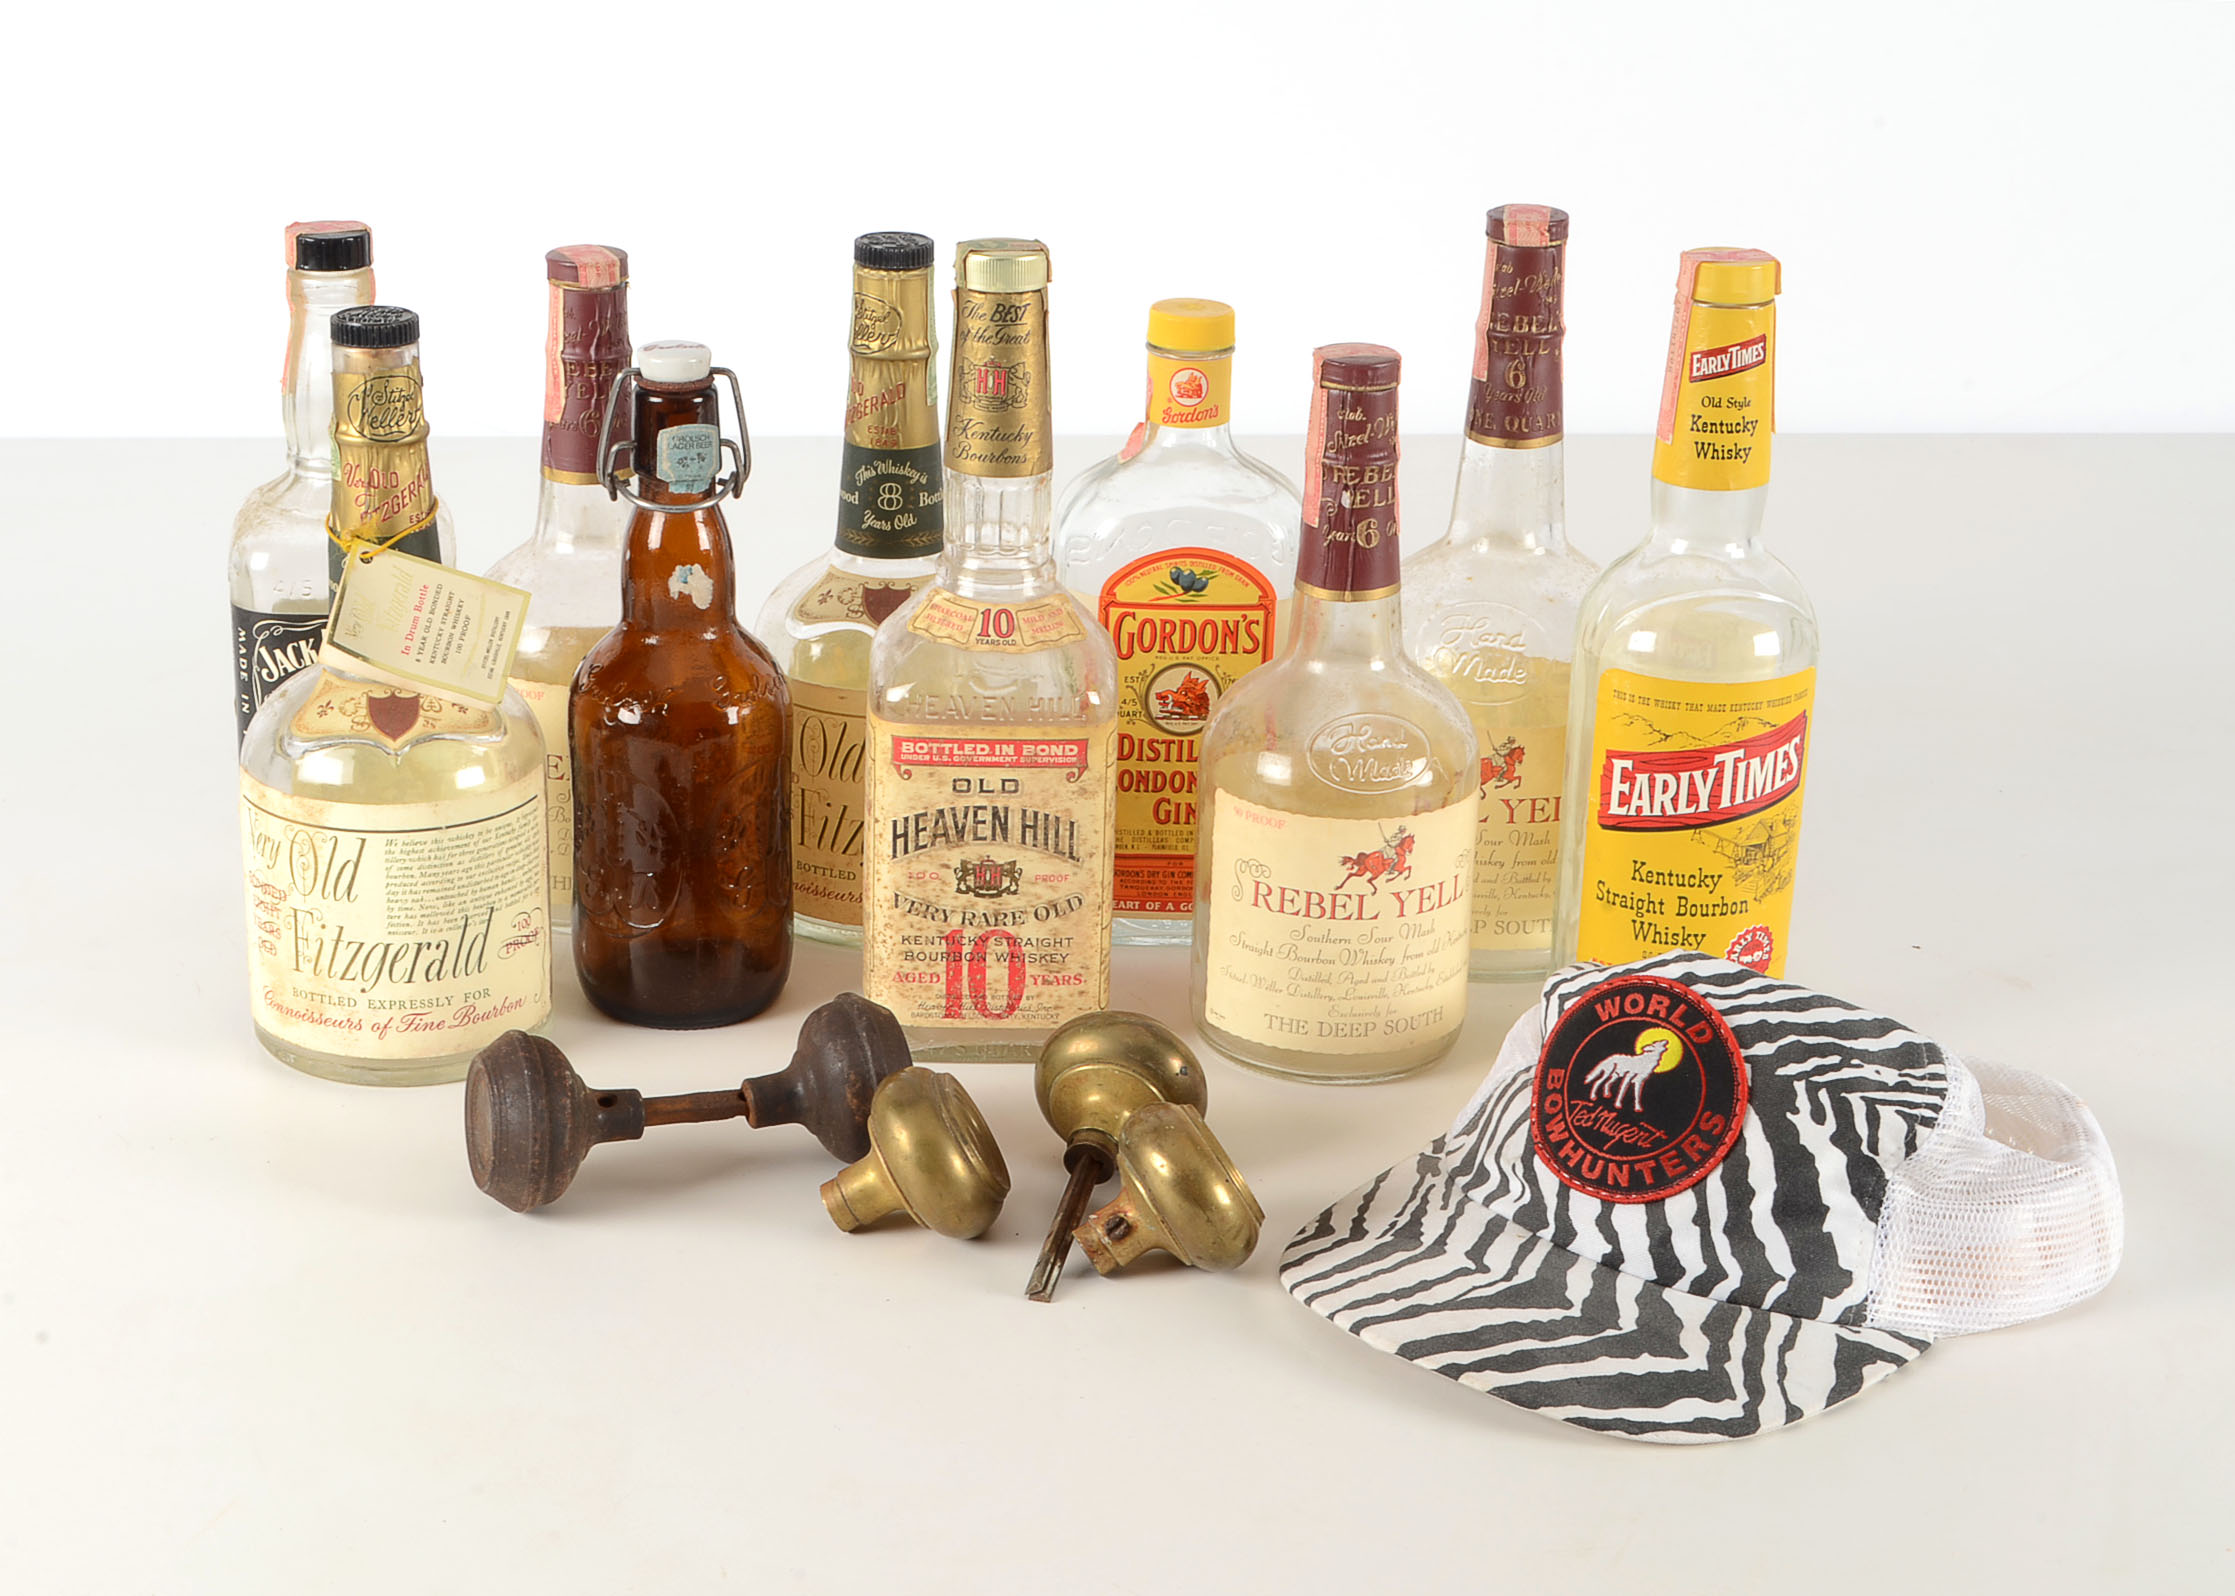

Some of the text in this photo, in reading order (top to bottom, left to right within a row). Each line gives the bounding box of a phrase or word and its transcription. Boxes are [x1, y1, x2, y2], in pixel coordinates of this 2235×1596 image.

[961, 300, 1030, 322] The BEST
[972, 326, 994, 345] the
[994, 326, 1032, 345] Great
[1504, 359, 1526, 390] 6
[1162, 404, 1219, 424] Gordon's
[1701, 396, 1752, 410] Old Style
[952, 416, 1033, 450] Kentucky
[1690, 414, 1758, 438] Kentucky
[952, 441, 1028, 465] Bourbons
[1694, 440, 1752, 464] Whisky
[370, 468, 400, 489] OLD
[855, 458, 928, 486] This Whiskey is
[878, 482, 902, 510] 8
[862, 509, 918, 531] Years Old
[1356, 518, 1380, 548] 6
[400, 584, 430, 656] In Drum Bottle
[430, 591, 455, 664] KENTUCKY STRAIGHT
[461, 614, 472, 642] PROOF
[978, 608, 1015, 640] 10
[416, 636, 428, 656] YEAR
[424, 617, 433, 634] OLD
[441, 632, 454, 664] BOURBON
[976, 638, 1017, 646] YEARS OLD
[1113, 611, 1260, 660] GORDON'S
[236, 626, 250, 714] MADE IN
[258, 635, 319, 682] JACK
[1638, 696, 1651, 706] THE
[1654, 698, 1681, 711] WHISKY
[1685, 702, 1704, 712] THAT
[1707, 704, 1727, 712] MADE
[1730, 701, 1762, 712] KENTUCKY
[900, 754, 930, 762] UNDER
[953, 756, 1018, 764] GOVERNMENT
[902, 741, 1079, 756] BOTTLED IN BOND
[952, 778, 1020, 795] OLD
[1117, 768, 1198, 794] ONDON
[892, 805, 1081, 862] HEAVEN HILL
[1245, 810, 1287, 830] PROOF
[1509, 829, 1550, 848] Mash
[283, 823, 366, 903] Old
[796, 860, 856, 882] BOTTLED
[1512, 849, 1558, 870] from old
[1034, 874, 1070, 883] PROOF
[1631, 860, 1722, 894] Kentucky
[893, 892, 1084, 927] VERY RARE OLD
[1146, 901, 1175, 910] OF A
[1252, 874, 1464, 921] REBEL YELL
[1596, 880, 1750, 918] Straight Bourbon
[1290, 918, 1436, 946] Southern Sour Mash
[1494, 918, 1552, 935] SOUT
[1631, 919, 1707, 950] Whisky
[286, 905, 494, 994] Fitzgerald
[901, 935, 1074, 948] KENTUCKY STRAIGHT
[1228, 931, 1274, 959] Straight
[1276, 943, 1336, 966] Bourbon
[1339, 947, 1396, 968] Whiskey
[904, 951, 1070, 964] BOURBON WHISKEY
[892, 972, 941, 985] AGED
[941, 928, 1026, 1020] 10
[1030, 974, 1084, 986] YEARS
[264, 984, 527, 1040] Connoisseurs of Fine Bourbon
[292, 986, 492, 1010] BOTTLED EXPRESSLY FOR
[1264, 1006, 1444, 1038] THE DEEP SOUTH
[1594, 992, 1715, 1045] WORLD
[1544, 1066, 1727, 1188] BOWHUNTERS
[1567, 1098, 1668, 1150] Ted Nugent
